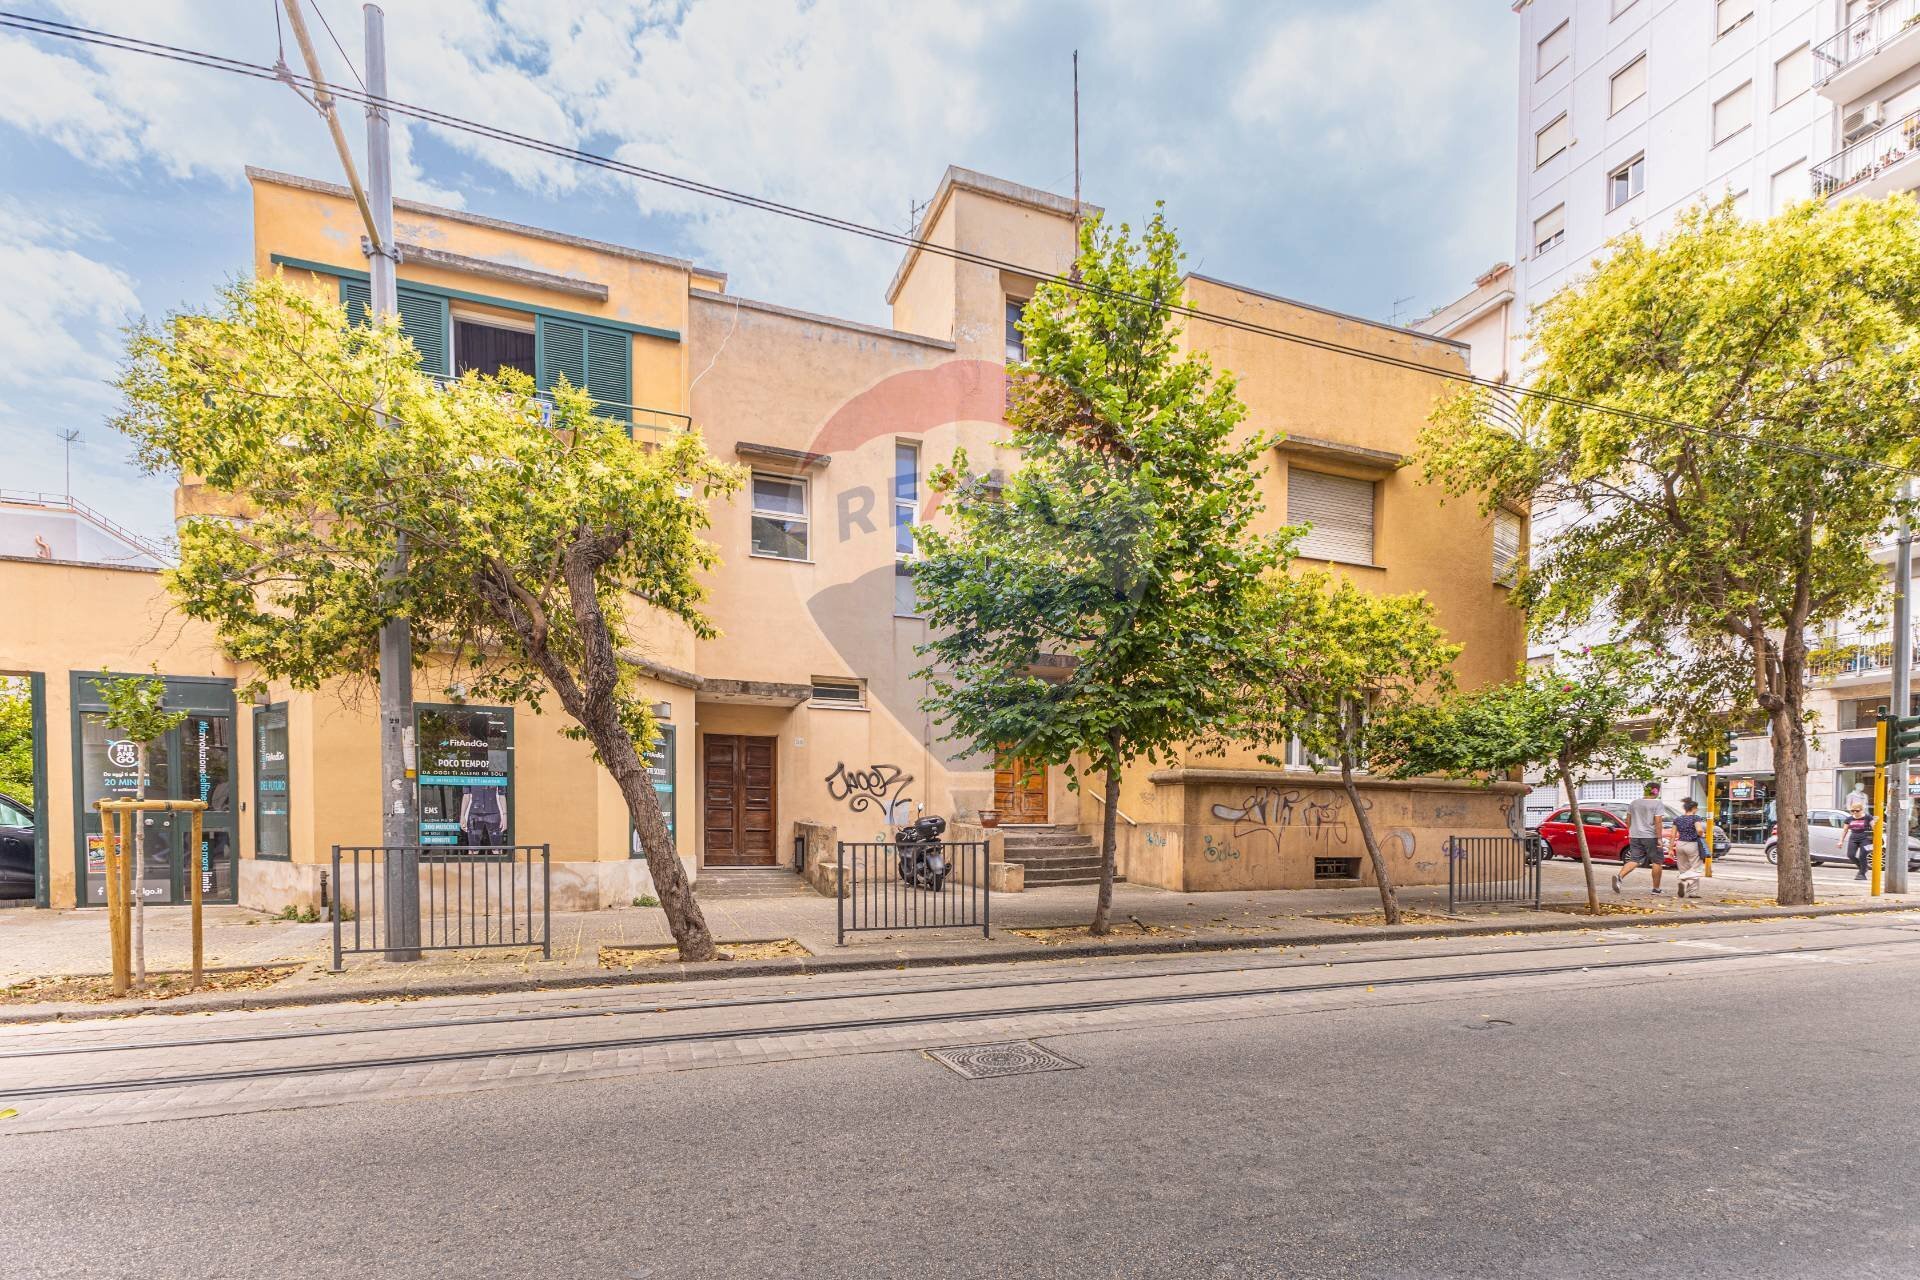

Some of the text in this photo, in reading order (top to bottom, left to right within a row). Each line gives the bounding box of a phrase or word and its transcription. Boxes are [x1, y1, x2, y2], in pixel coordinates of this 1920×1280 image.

[449, 739, 489, 748] FitAndGo
[116, 756, 135, 764] GO
[199, 721, 211, 803] #larivoluzionedelfitne
[438, 759, 490, 768] POCO TEMPO?
[104, 778, 151, 786] 20 MINTI
[424, 806, 439, 814] EMS
[201, 841, 212, 893] no more limits
